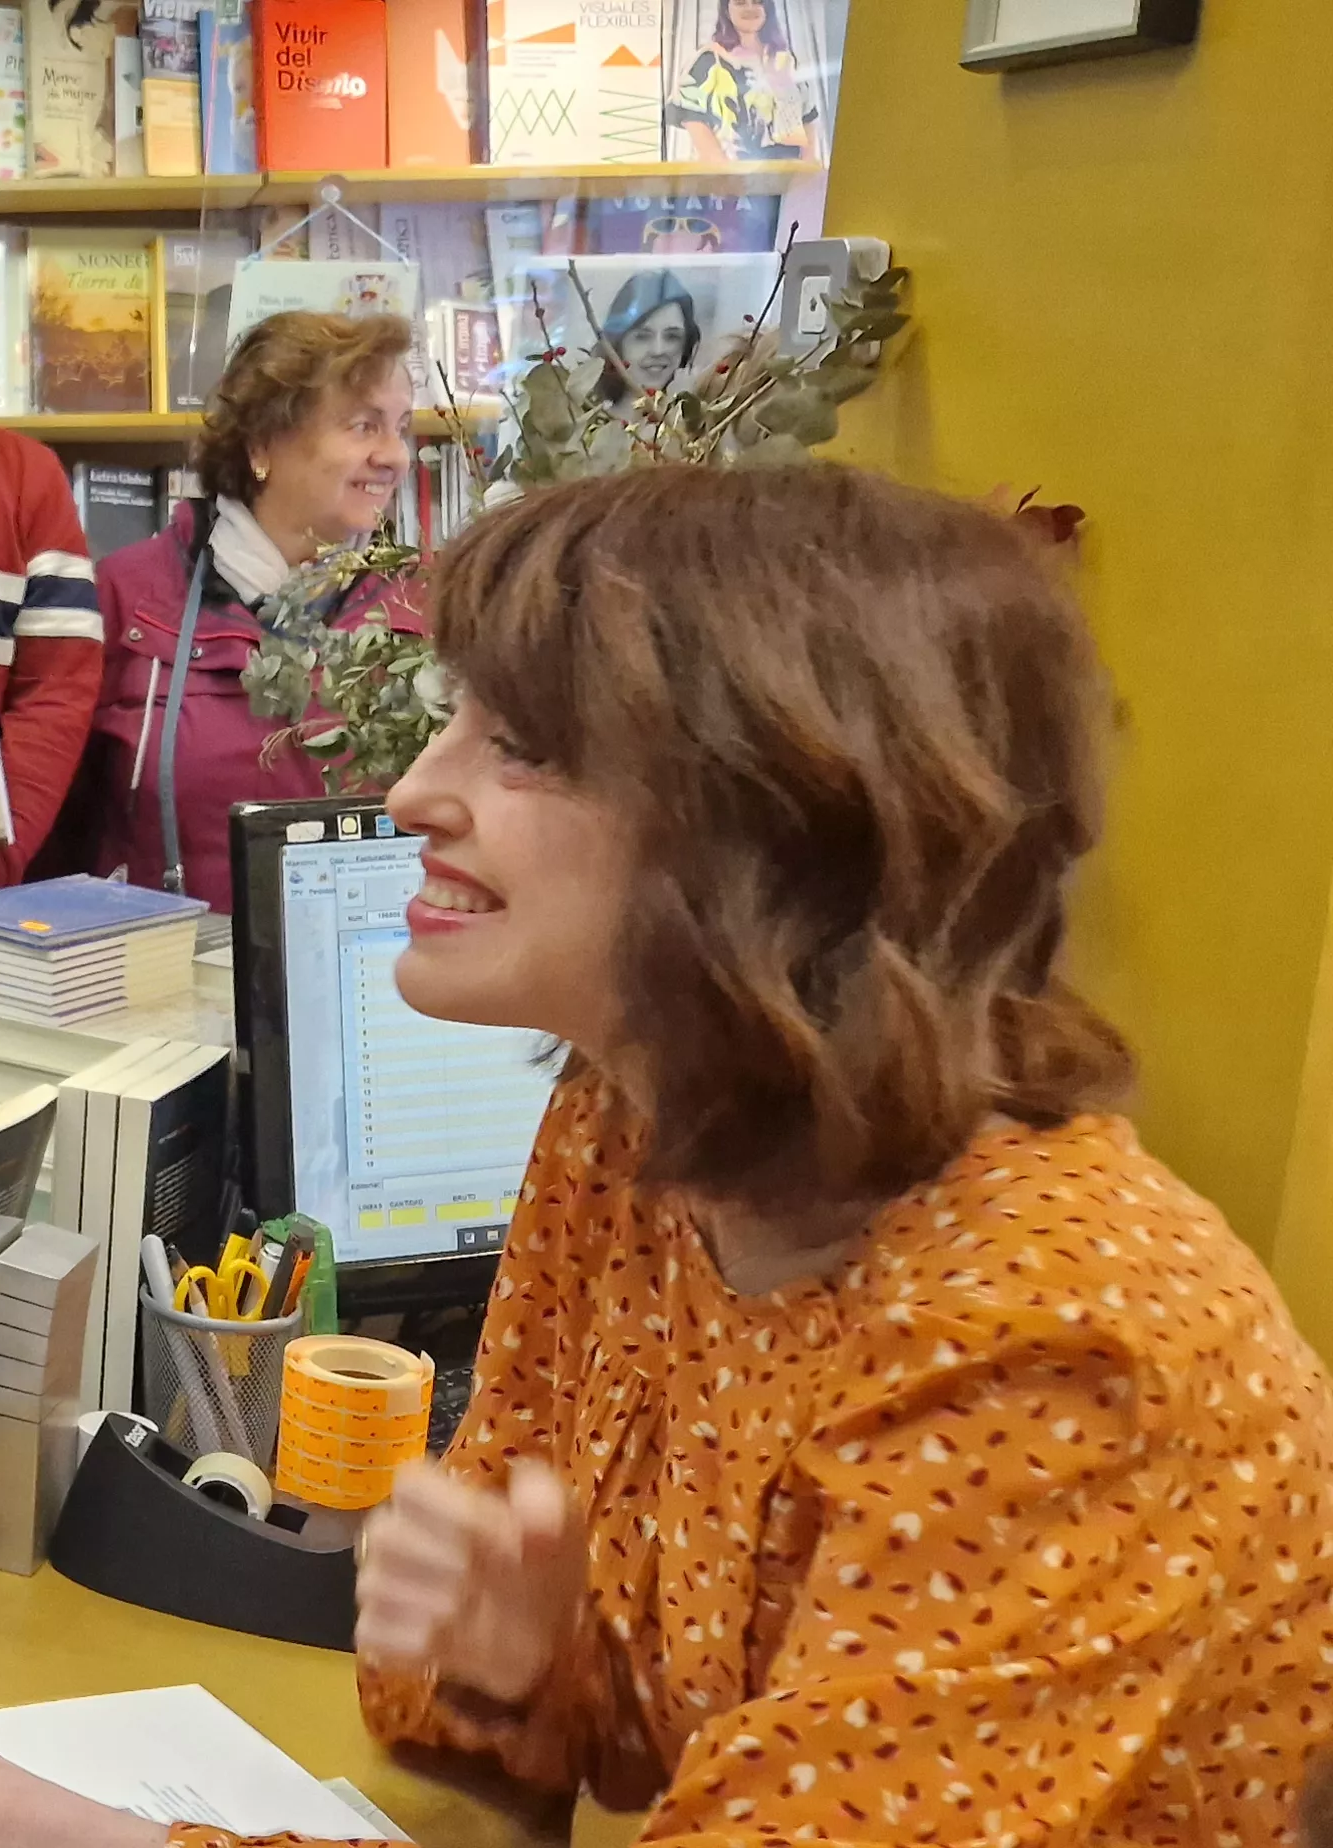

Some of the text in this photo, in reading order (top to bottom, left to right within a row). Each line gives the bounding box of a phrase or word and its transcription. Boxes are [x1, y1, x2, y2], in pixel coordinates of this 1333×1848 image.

[579, 1, 650, 14] VISUALES
[580, 14, 656, 28] FLEXIBLES
[275, 21, 328, 45] Vivir
[276, 46, 312, 68] del
[68, 271, 117, 289] Tierra
[389, 1199, 424, 1208] CANTIDAD
[452, 1193, 477, 1202] BRUTO
